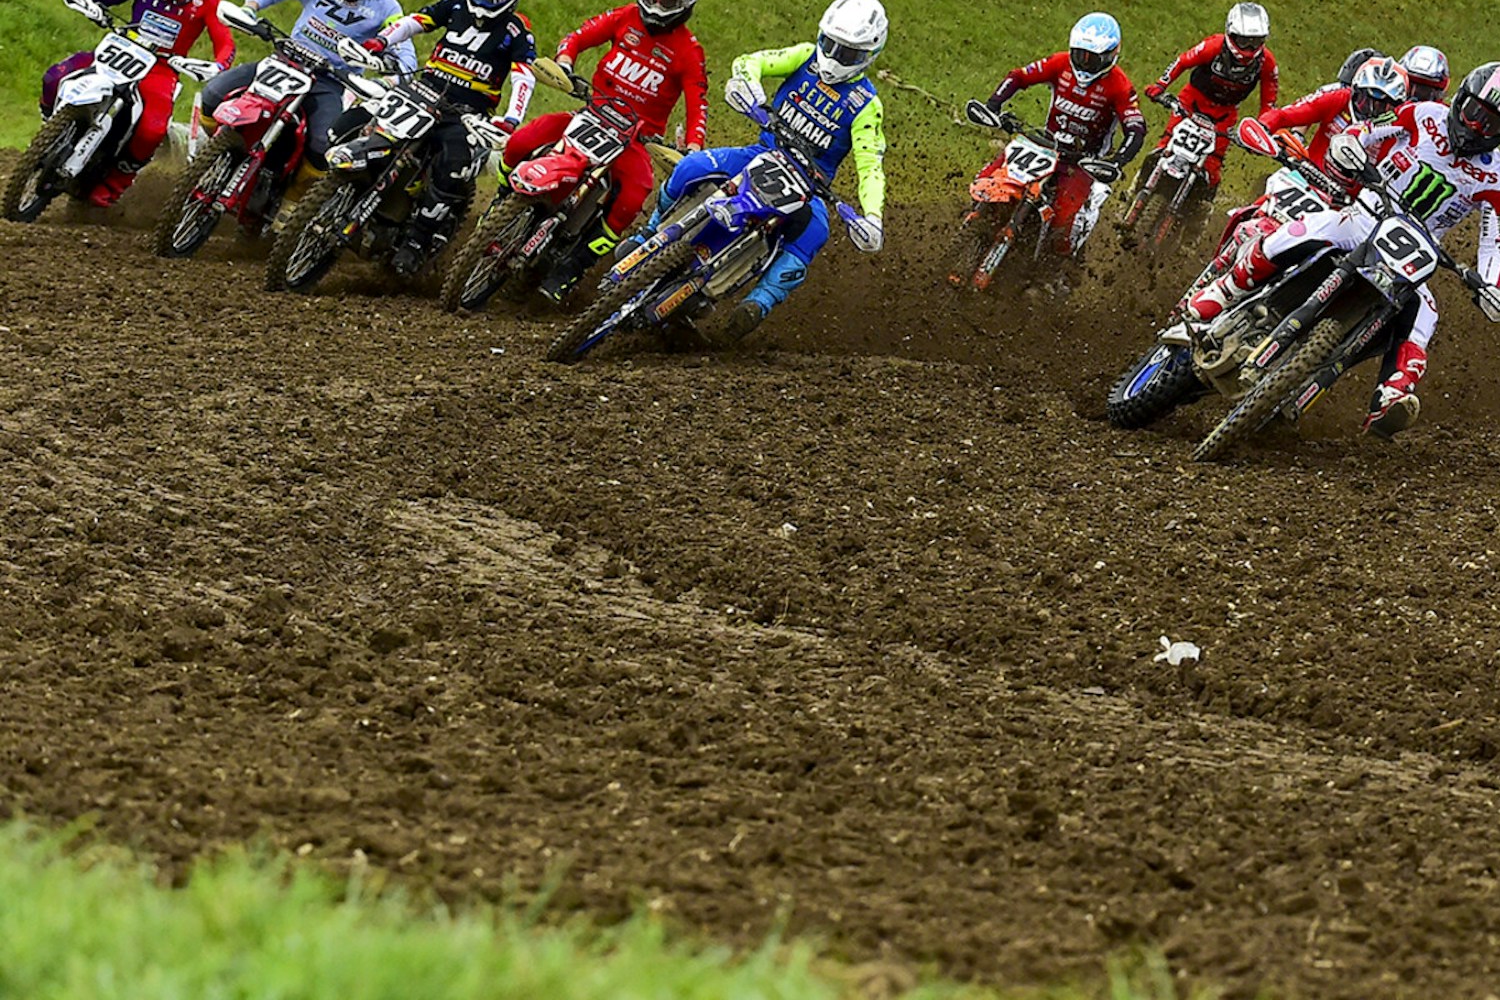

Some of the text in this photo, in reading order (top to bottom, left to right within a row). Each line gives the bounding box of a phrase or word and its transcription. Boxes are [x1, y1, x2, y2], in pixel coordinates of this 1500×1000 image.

[445, 26, 491, 52] J1
[97, 44, 147, 79] 500
[256, 65, 307, 92] 103
[439, 47, 494, 81] racing
[605, 51, 665, 93] JWR
[377, 94, 433, 139] 371
[787, 90, 841, 132] CRESCENT
[798, 80, 845, 121] SEVEN
[567, 118, 622, 160] 161
[777, 100, 834, 150] YAMAHA
[1173, 127, 1212, 159] 337
[1006, 146, 1052, 178] 142
[1448, 156, 1498, 184] years
[1376, 226, 1435, 271] 91
